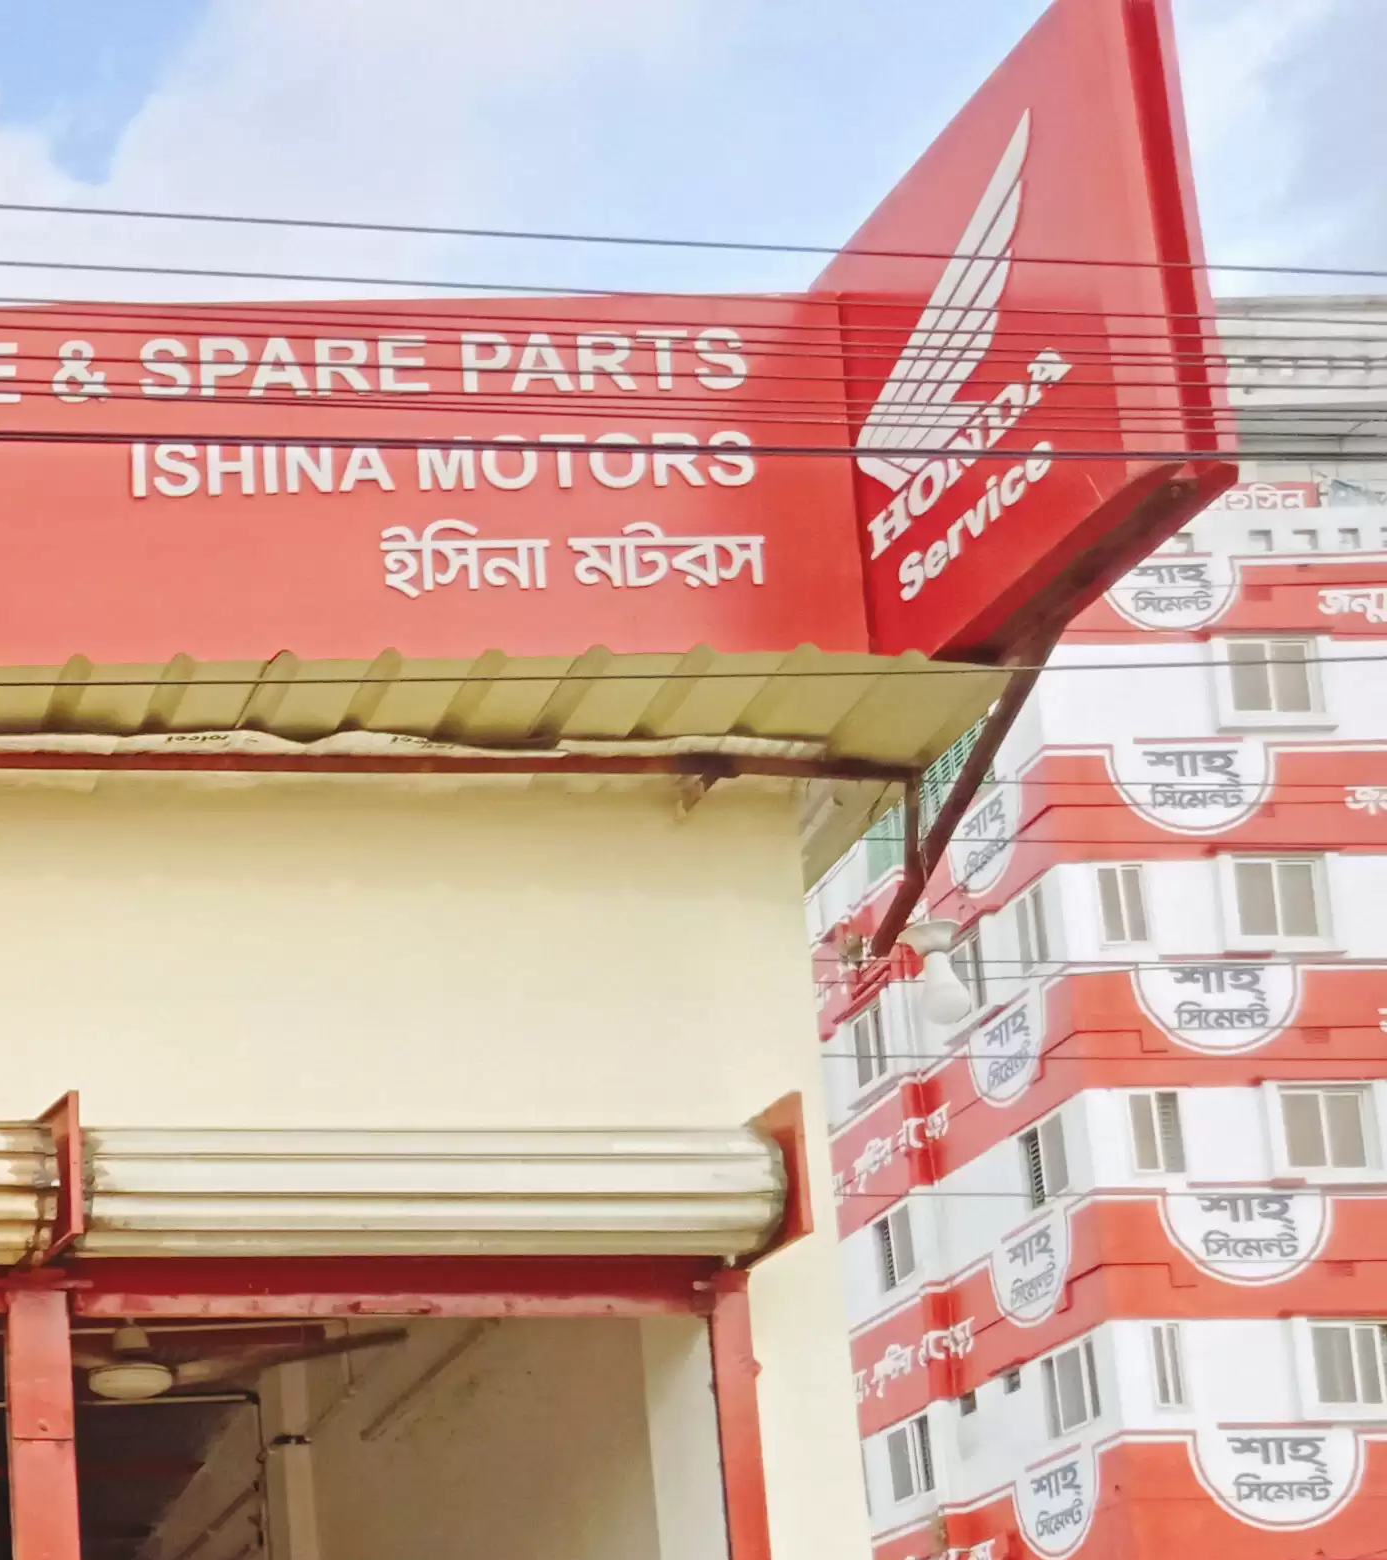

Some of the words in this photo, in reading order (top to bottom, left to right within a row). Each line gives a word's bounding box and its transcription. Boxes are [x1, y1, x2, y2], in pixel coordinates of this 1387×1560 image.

[50, 340, 113, 403] &
[138, 335, 430, 397] SPARE
[461, 327, 748, 393] PARTS
[131, 440, 395, 498] ISHINA
[417, 431, 756, 491] MOTORS
[867, 347, 1072, 560] HONDA
[899, 441, 1053, 601] Service
[380, 519, 550, 599] ইসিনা
[568, 521, 766, 588] মটরস
[1149, 782, 1243, 809] সিমেন্ট
[1174, 1001, 1270, 1029] সিমেন্ট
[1201, 1230, 1299, 1257] সিমেন্ট
[1232, 1472, 1333, 1502] সিমেন্ট
